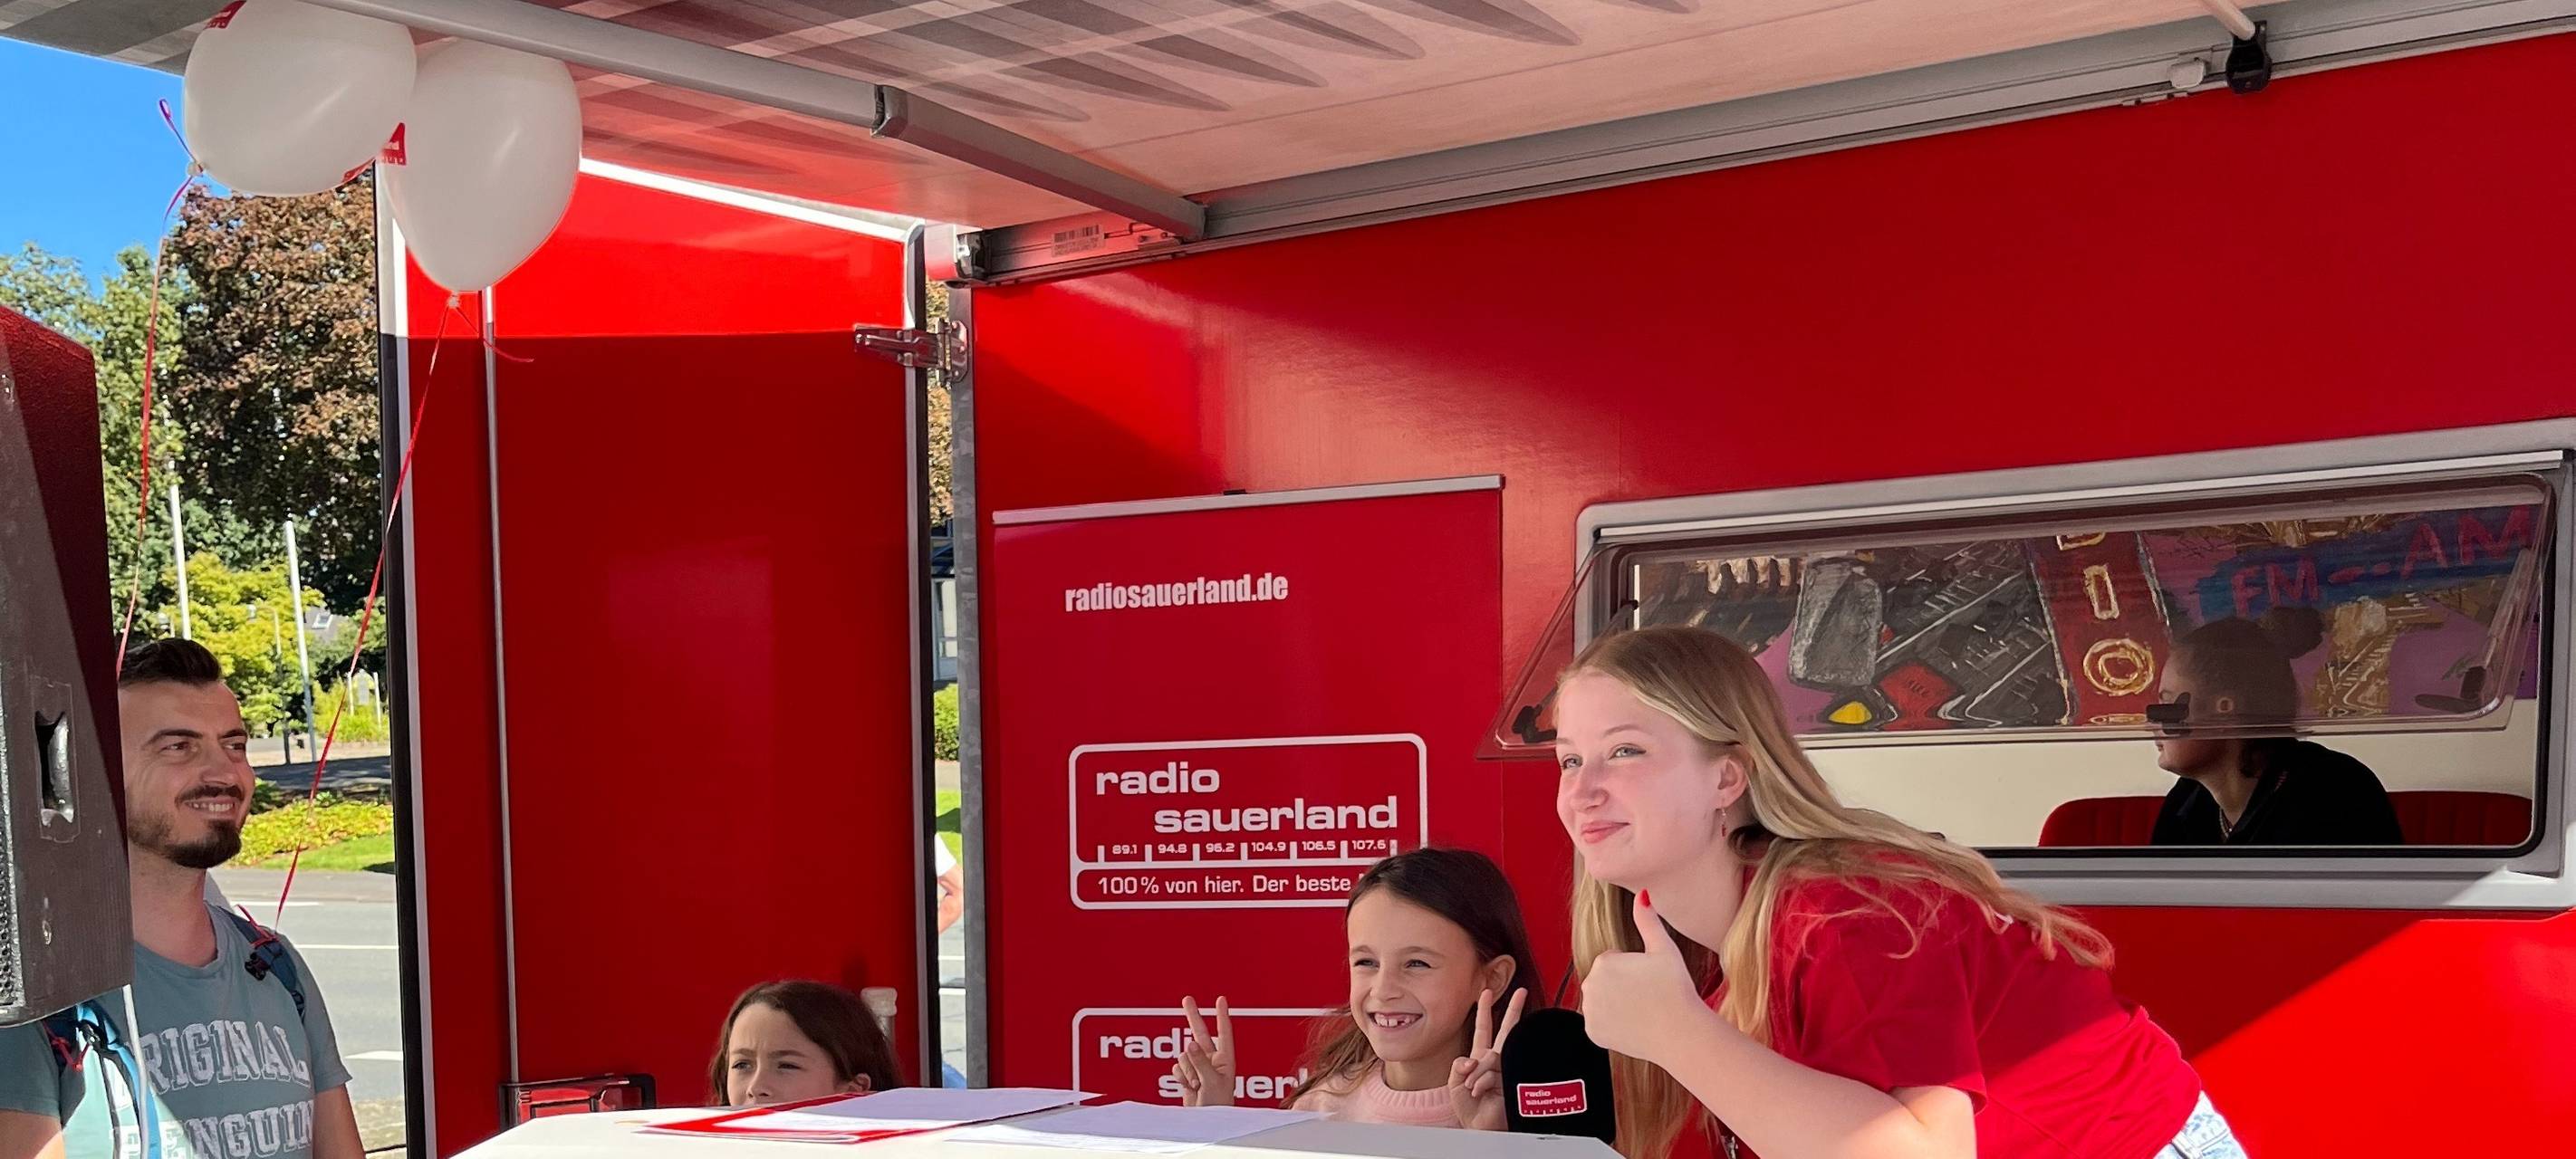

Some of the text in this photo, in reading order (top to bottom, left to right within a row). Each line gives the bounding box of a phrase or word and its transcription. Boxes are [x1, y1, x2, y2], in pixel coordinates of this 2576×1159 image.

[1064, 571, 1289, 612] radiosauerland.de
[1096, 761, 1220, 795] radio
[1154, 795, 1398, 833] sauerland
[1111, 838, 1387, 855] 89.1 94.8 96.2 104.9 106.5 107.6
[1165, 880, 1197, 894] von
[1205, 875, 1245, 894] hier.
[1252, 874, 1290, 893] Der
[1295, 873, 1351, 892] beste
[1100, 1027, 1219, 1059] radi
[1524, 1089, 1552, 1097] radio
[1525, 1094, 1577, 1106] sauerland
